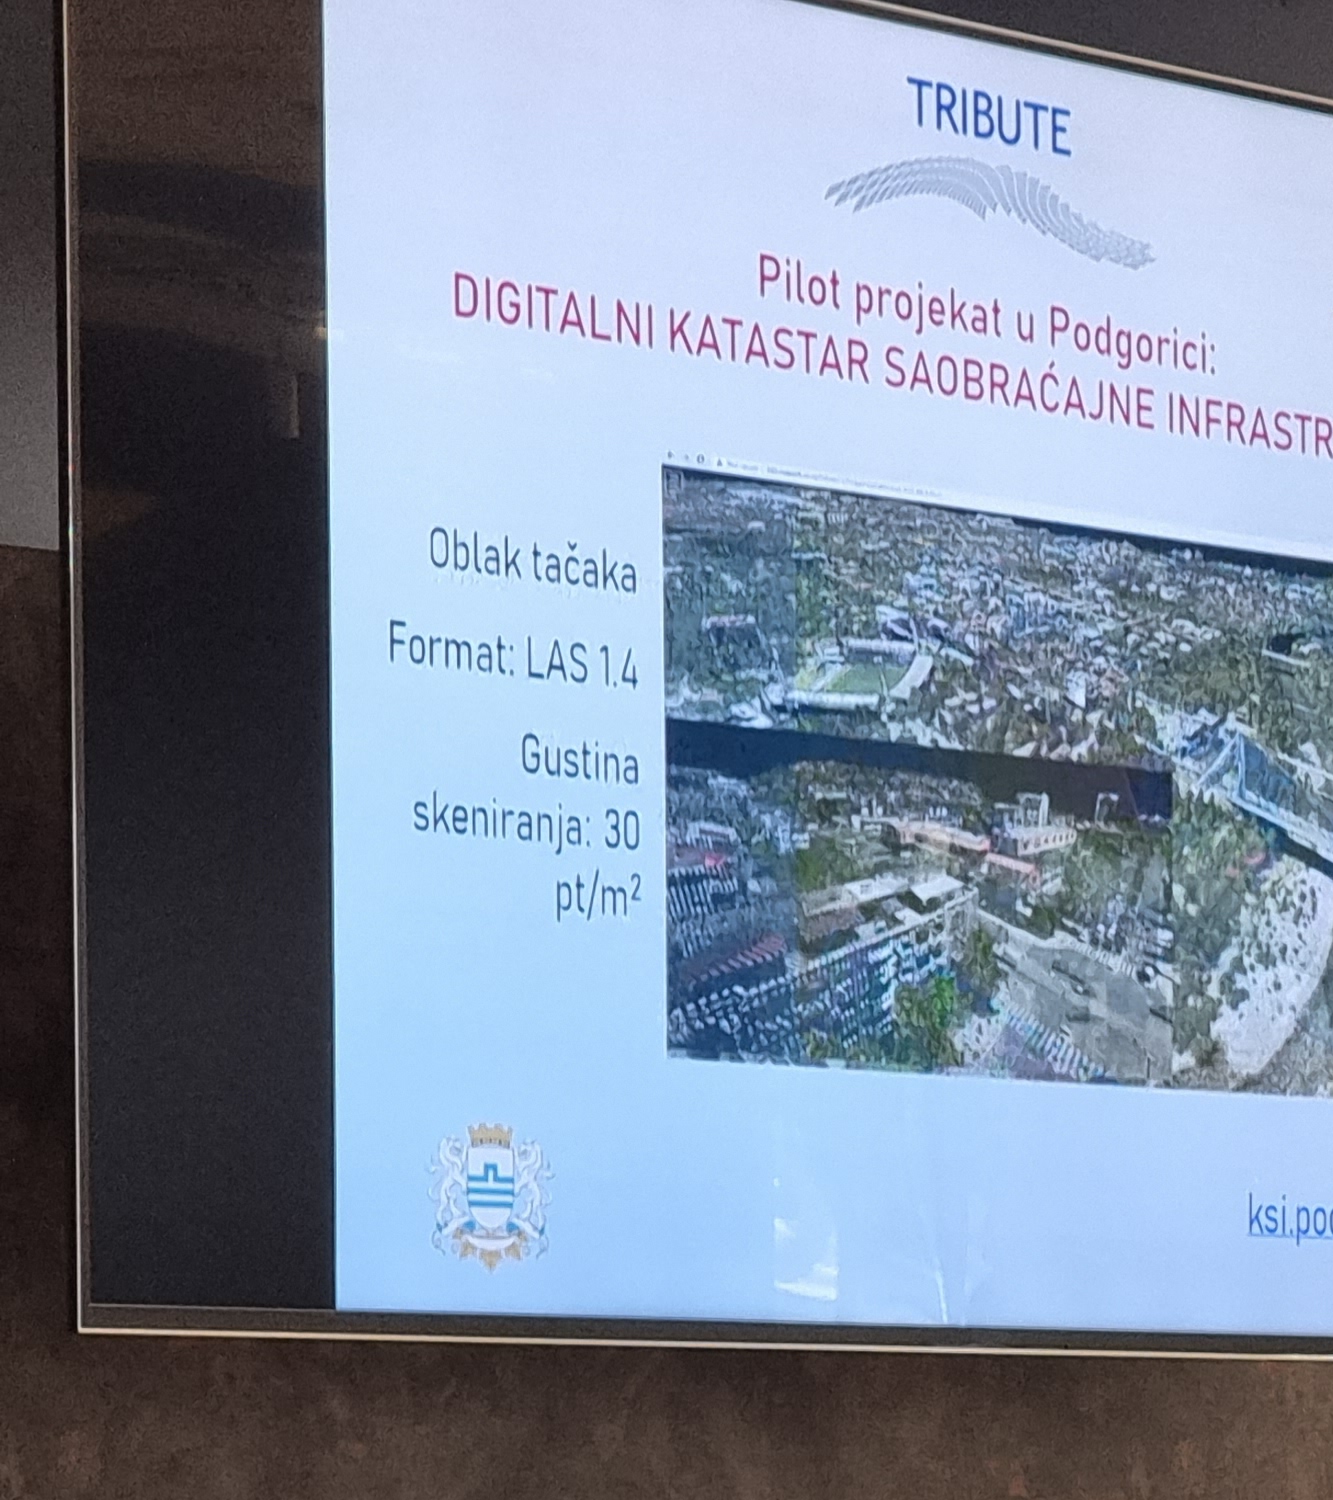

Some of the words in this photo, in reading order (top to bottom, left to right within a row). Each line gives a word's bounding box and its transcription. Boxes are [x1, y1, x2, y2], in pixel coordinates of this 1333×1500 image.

[907, 75, 1071, 157] TRIBUTE
[759, 253, 840, 310] Pilot
[856, 280, 1002, 338] projekat
[1016, 309, 1034, 344] u
[1049, 304, 1216, 376] Podgorici:
[454, 271, 654, 350] DIGITALNI
[669, 306, 870, 385] KATASTAR
[884, 346, 1155, 430] SAOBRAĆAJNE
[429, 526, 522, 580] Oblak
[532, 540, 638, 595] tačaka
[388, 619, 516, 677] Format:
[525, 636, 589, 685] LAS
[599, 644, 639, 690] 1.4
[521, 732, 640, 786] Gustina
[412, 790, 592, 855] skeniranja:
[604, 808, 641, 851] 30
